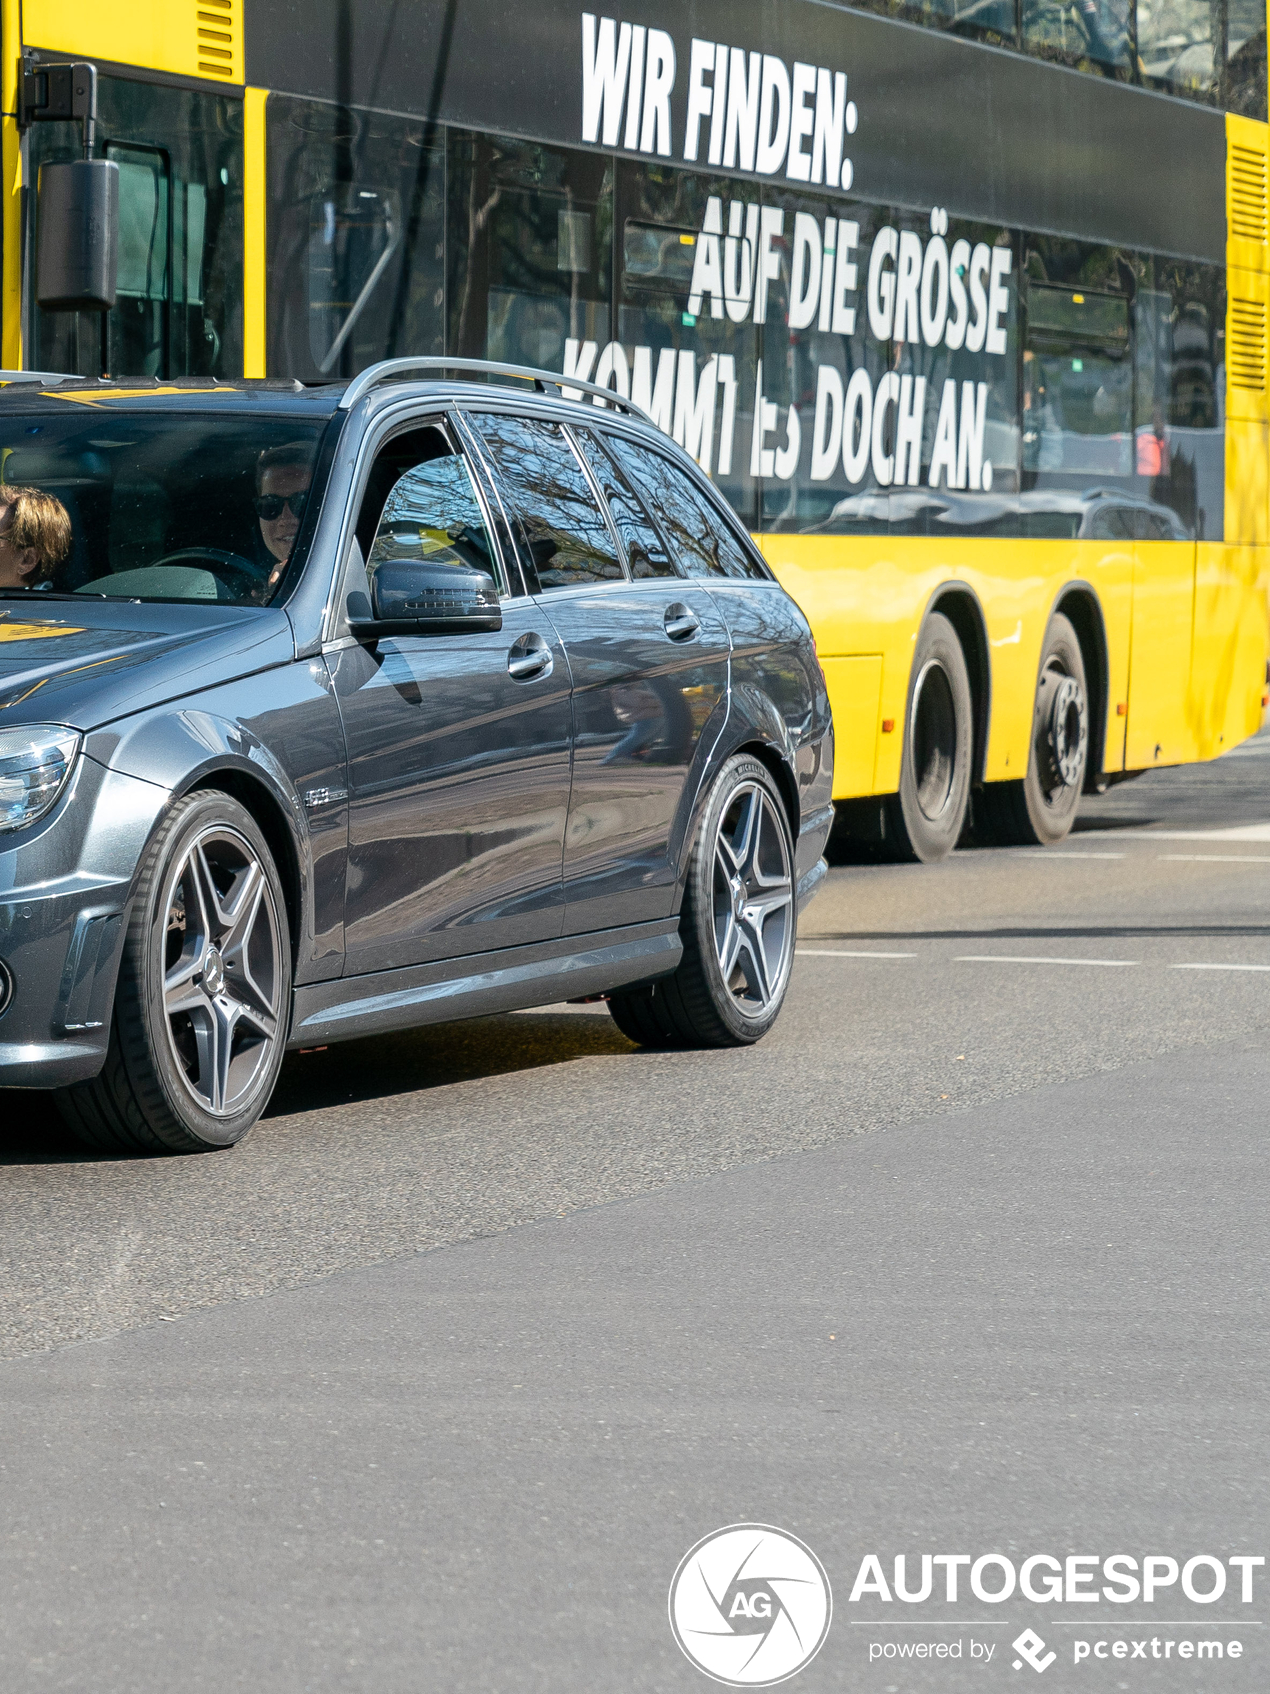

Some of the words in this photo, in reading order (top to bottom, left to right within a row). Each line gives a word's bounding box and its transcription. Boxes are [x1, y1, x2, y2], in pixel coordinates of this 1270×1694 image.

[581, 12, 677, 157] WIR
[683, 37, 858, 191] FINDEN:
[688, 195, 784, 325] AUF
[788, 211, 860, 335] DIE
[867, 205, 1013, 355] GRÖSSE
[750, 357, 802, 480] ES
[810, 363, 927, 487] DOCH
[930, 378, 994, 492] AN.
